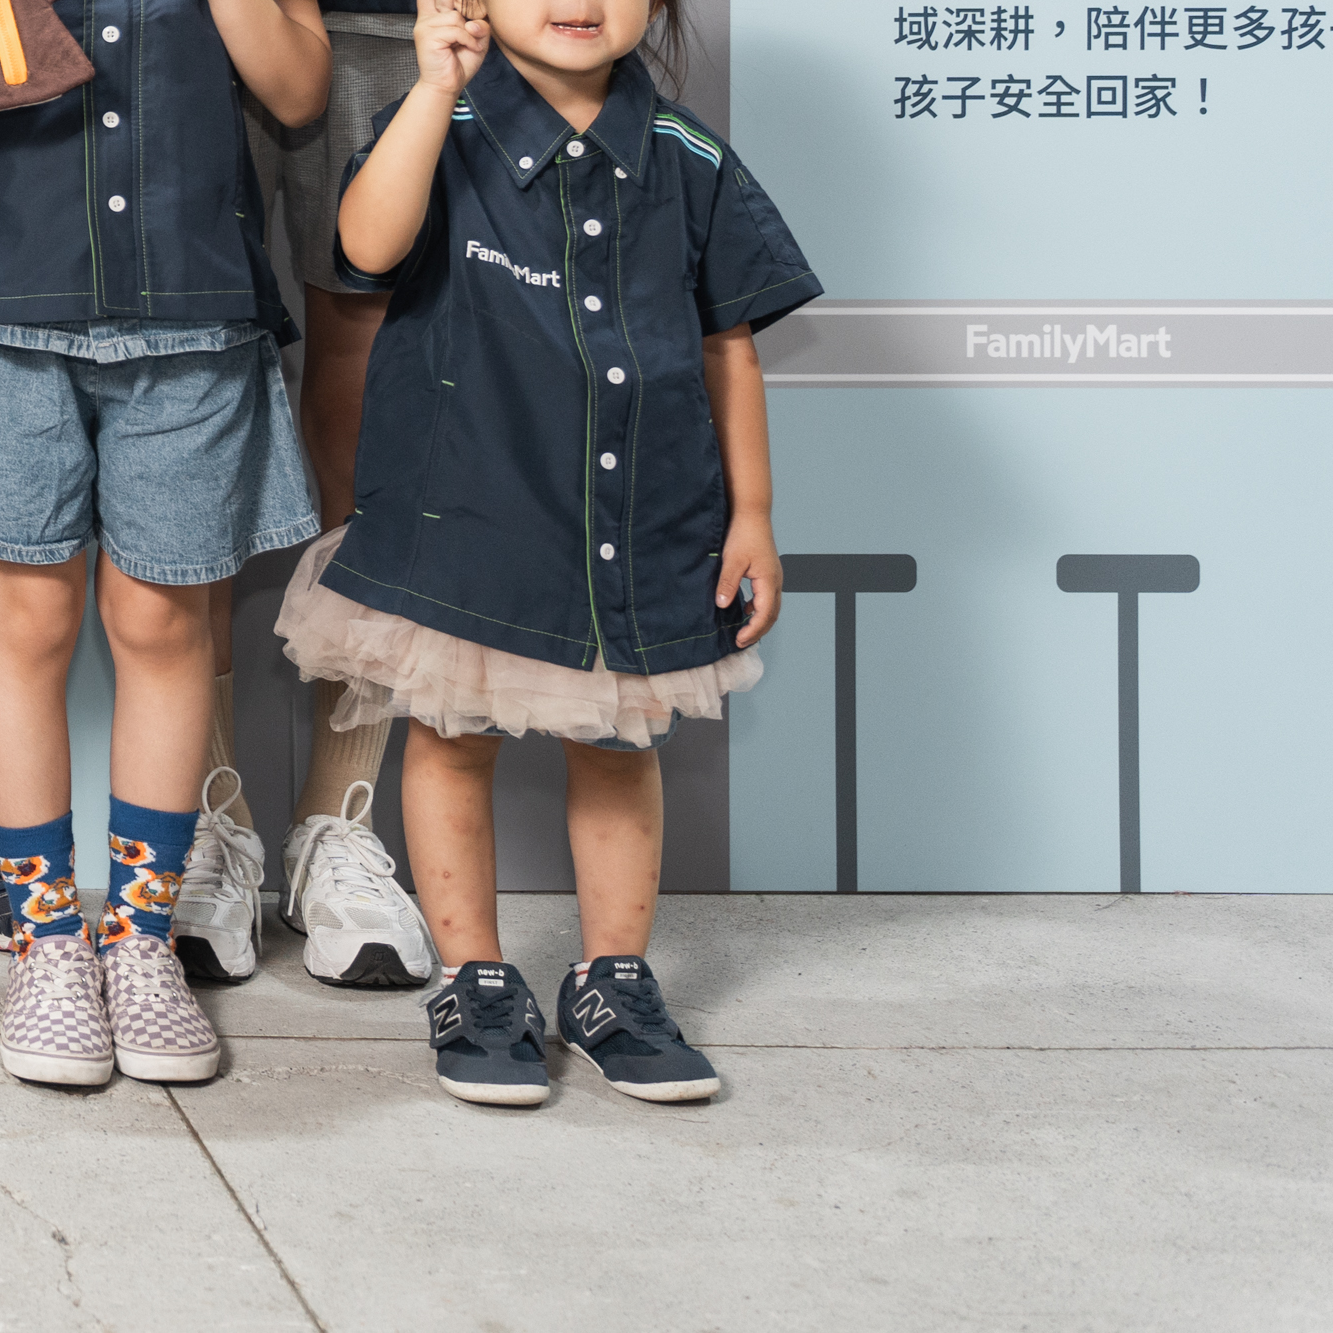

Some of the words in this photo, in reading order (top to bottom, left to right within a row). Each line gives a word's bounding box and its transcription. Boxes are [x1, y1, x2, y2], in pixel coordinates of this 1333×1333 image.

[893, 5, 1333, 51] 域深耕，陪伴更多孩
[893, 73, 1209, 120] 孩子安全回家！
[965, 324, 1172, 363] FamilyMart
